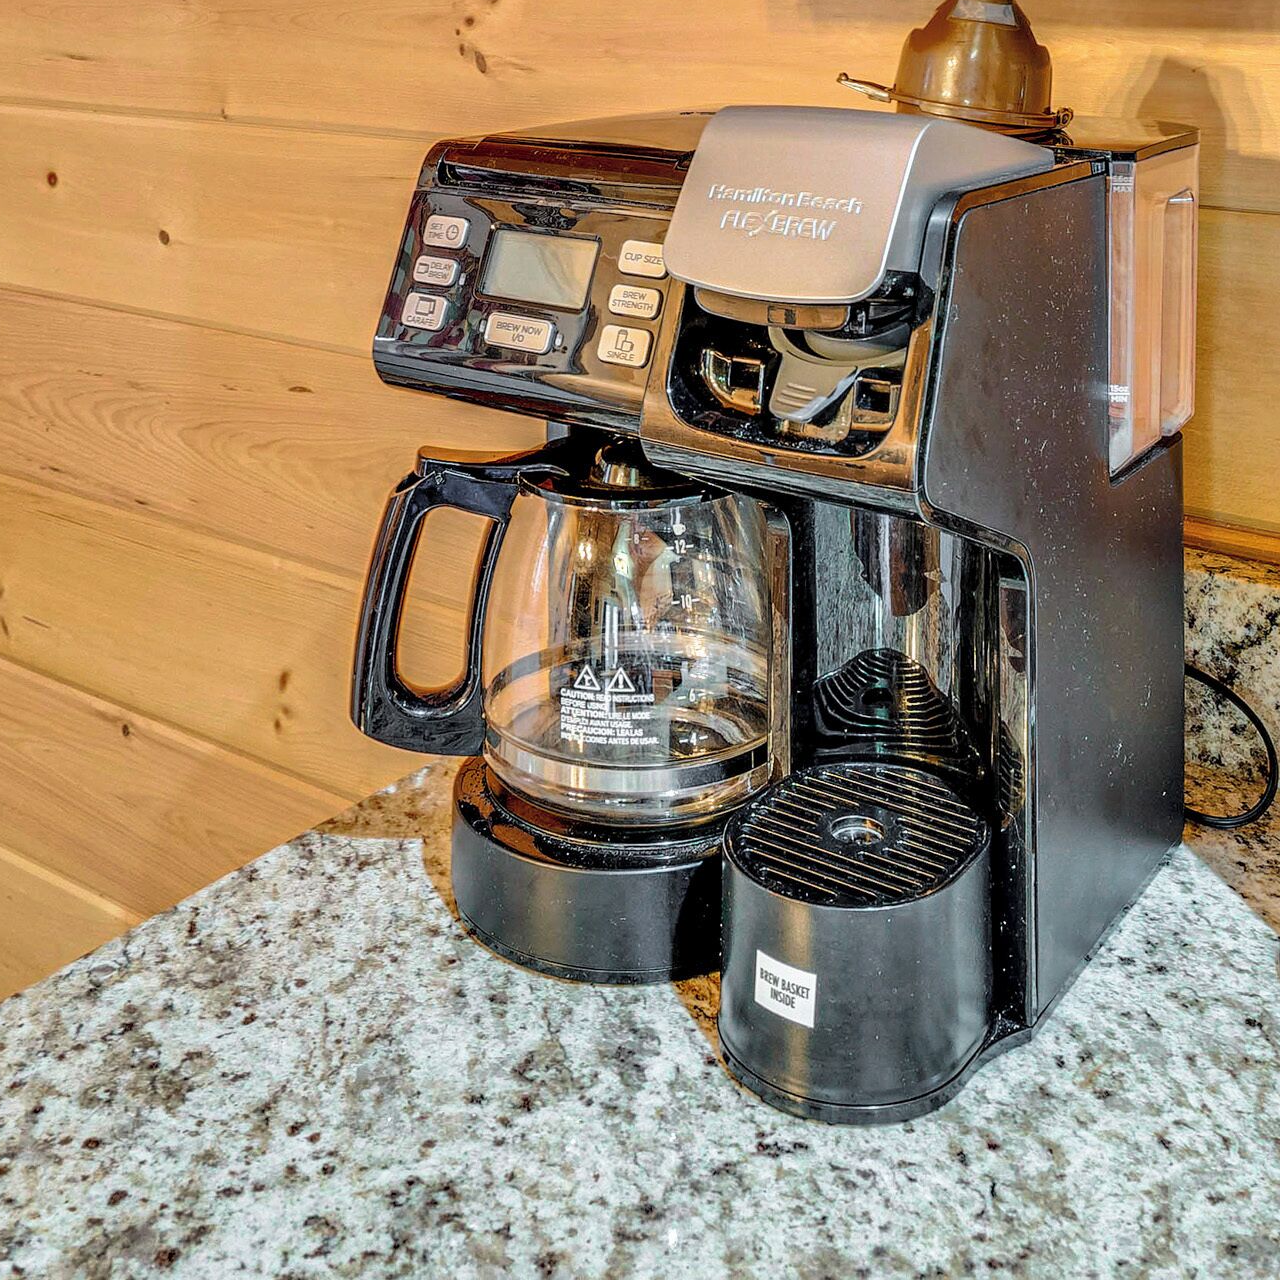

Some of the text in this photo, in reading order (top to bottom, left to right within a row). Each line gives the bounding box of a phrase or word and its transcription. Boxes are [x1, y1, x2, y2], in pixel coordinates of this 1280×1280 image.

[708, 183, 864, 215] Hamilton Beach
[429, 223, 444, 231] SET
[428, 231, 445, 240] TIME
[624, 252, 663, 266] CUP SIZE
[430, 261, 453, 271] DELAY
[428, 270, 449, 280] BREW
[622, 290, 647, 301] BREW
[612, 298, 654, 312] STRENGTH
[406, 315, 436, 327] CARAFE
[495, 321, 543, 336] BREW NOW
[606, 350, 635, 362] SINGLE
[633, 533, 640, 545] 8
[674, 539, 687, 554] 12
[680, 594, 692, 609] 10
[560, 688, 596, 701] CAUTION:
[612, 693, 655, 702] INSTRUCTIONS
[688, 689, 696, 702] 6
[560, 697, 586, 708] BEFORE
[560, 706, 608, 719] ATTENTION:
[622, 712, 631, 720] LE
[631, 712, 651, 720] MODE
[560, 715, 589, 725] D'EMPLOI
[589, 720, 609, 728] AVANT
[607, 737, 629, 745] ANTES
[689, 732, 697, 746] 4
[760, 967, 811, 999] BREW BASKET
[770, 987, 796, 1009] INSIDE
